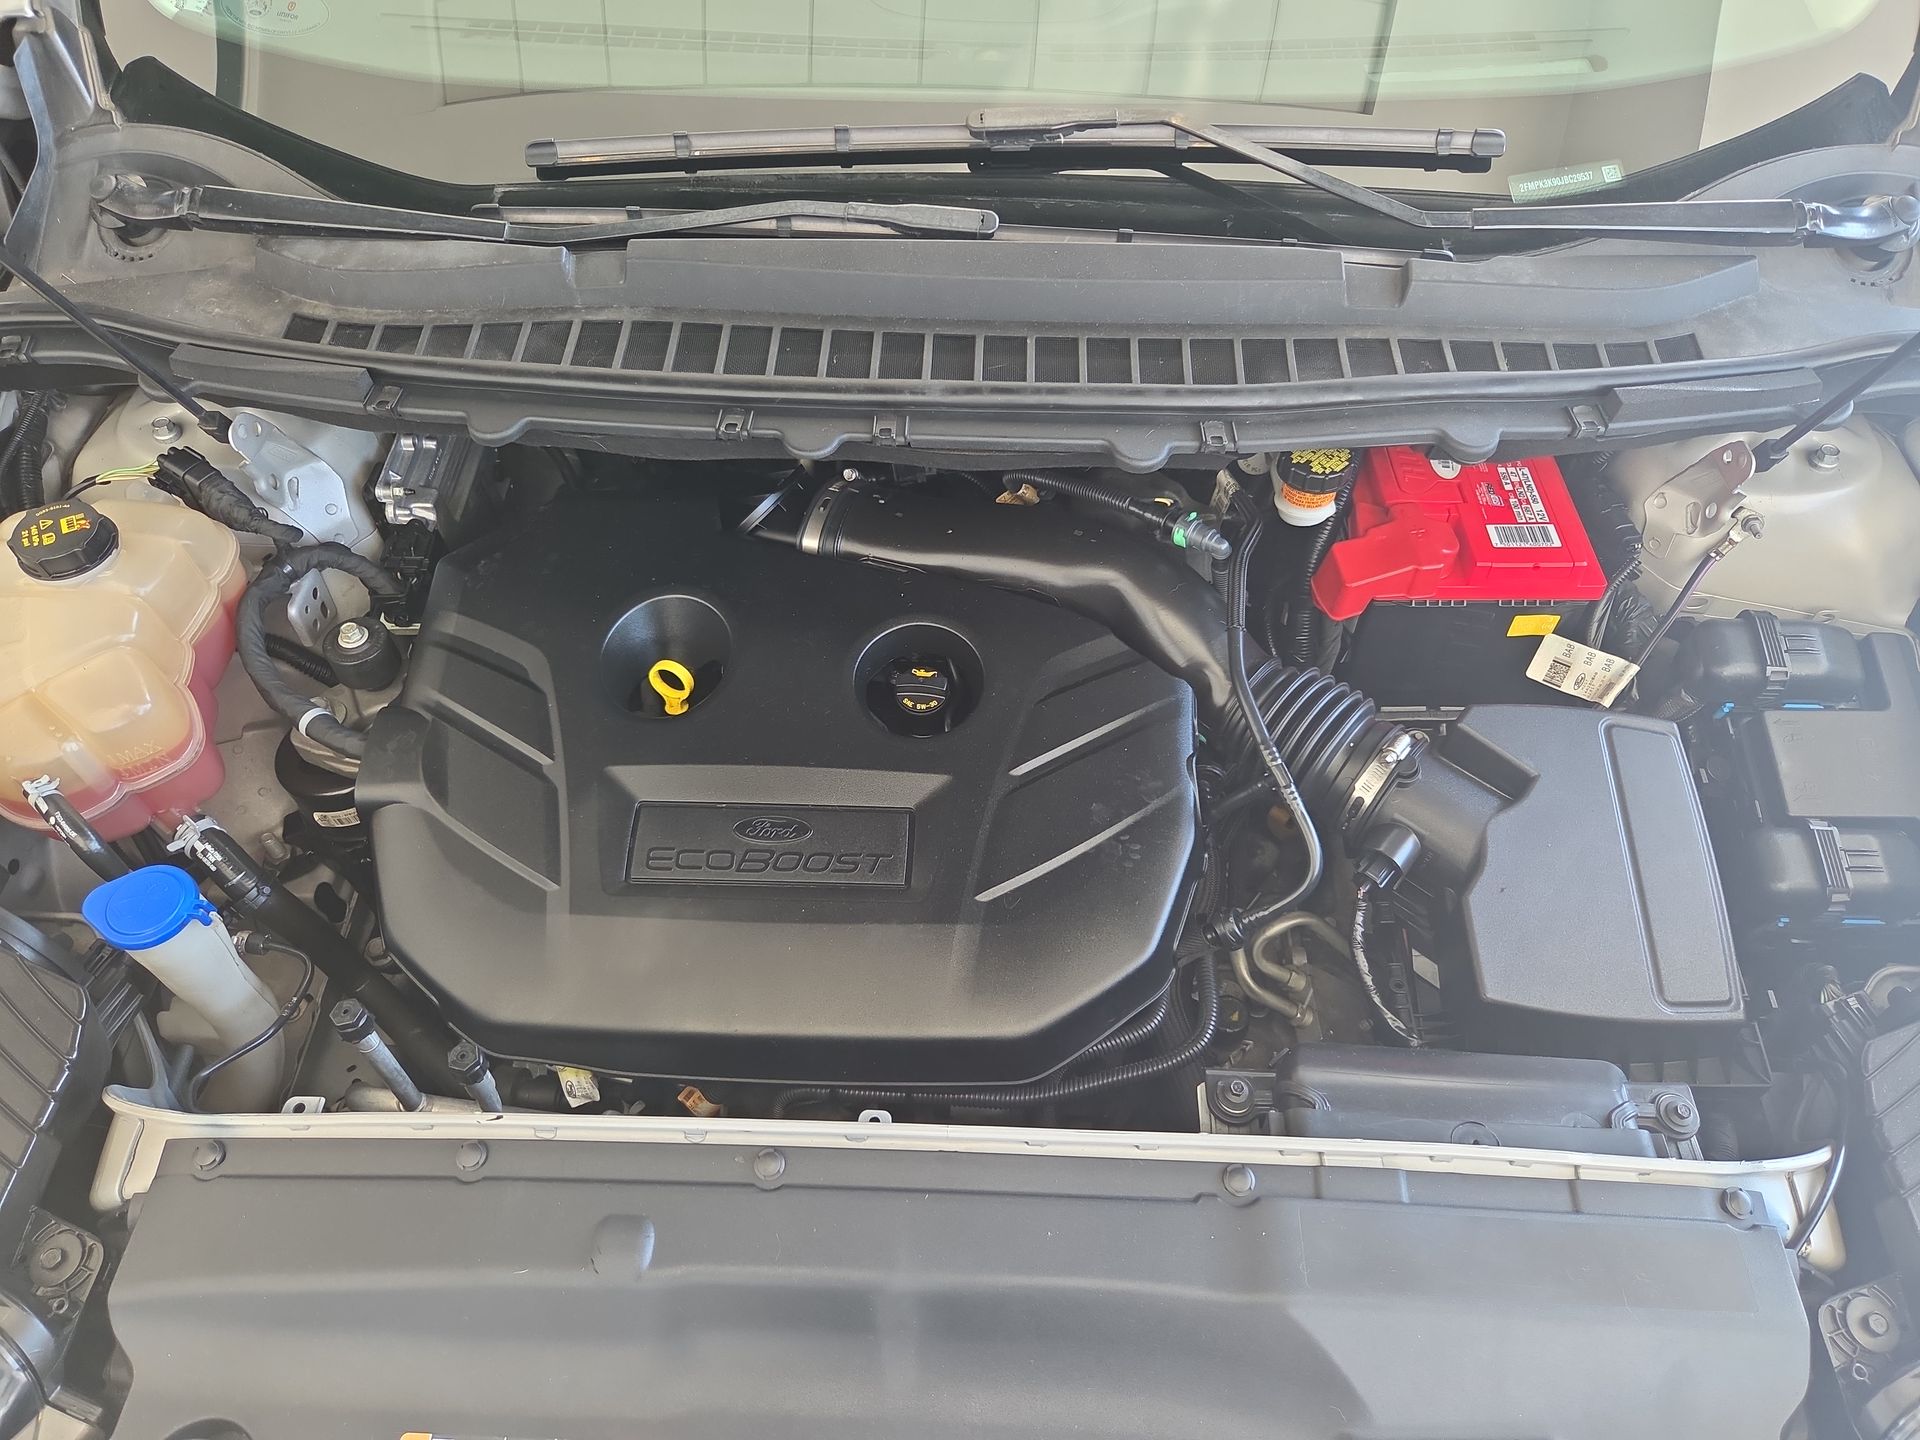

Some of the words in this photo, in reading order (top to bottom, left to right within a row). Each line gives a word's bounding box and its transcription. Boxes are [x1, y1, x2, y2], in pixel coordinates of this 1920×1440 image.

[1562, 643, 1576, 658] BAB
[1583, 651, 1597, 666] BAB
[1601, 658, 1616, 674] BAB
[902, 697, 914, 708] SAE
[916, 699, 938, 710] 5W-30
[743, 818, 802, 840] Ford
[646, 846, 894, 875] ECOBOOST
